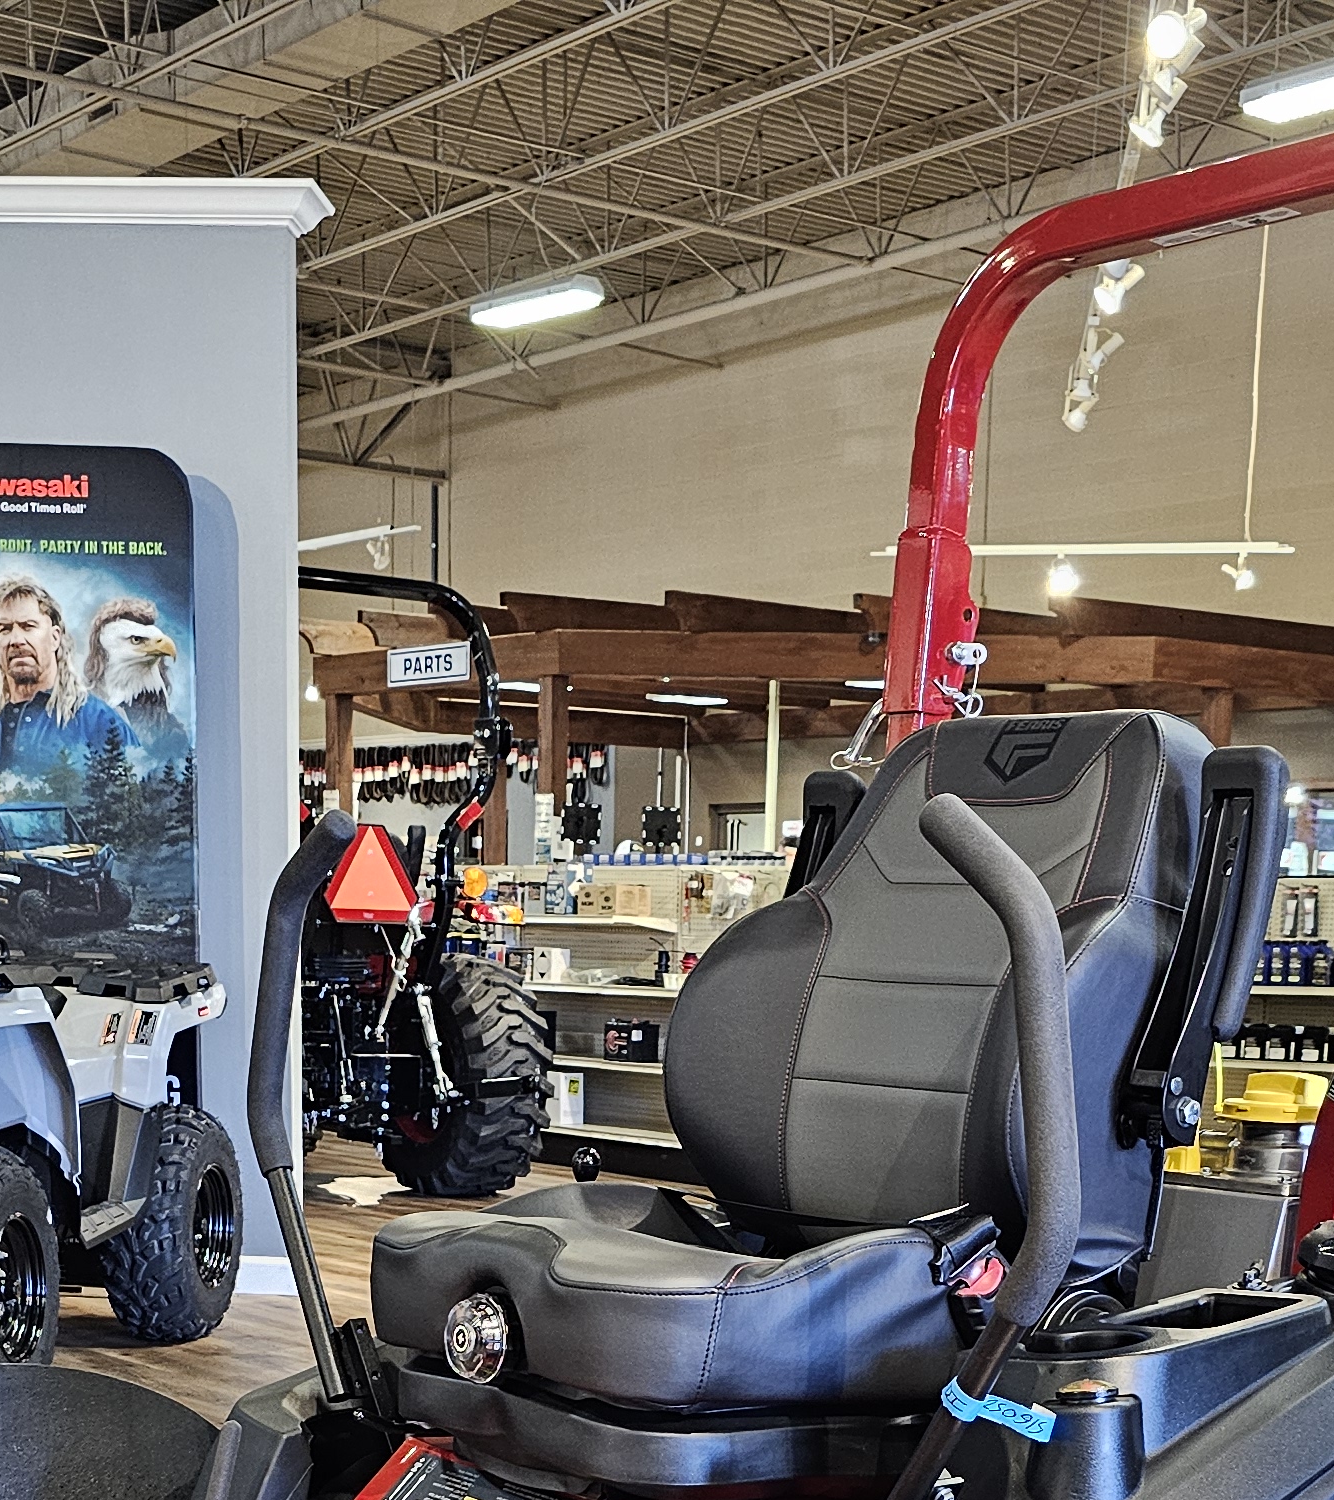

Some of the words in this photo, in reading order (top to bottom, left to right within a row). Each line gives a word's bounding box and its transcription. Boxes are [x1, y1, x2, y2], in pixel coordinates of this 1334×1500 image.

[1, 502, 28, 513] Good
[30, 503, 61, 513] Times
[40, 540, 81, 554] PARTY
[85, 541, 98, 554] IN
[101, 541, 125, 555] THE
[129, 542, 167, 556] BACK.
[403, 653, 453, 676] PARTS
